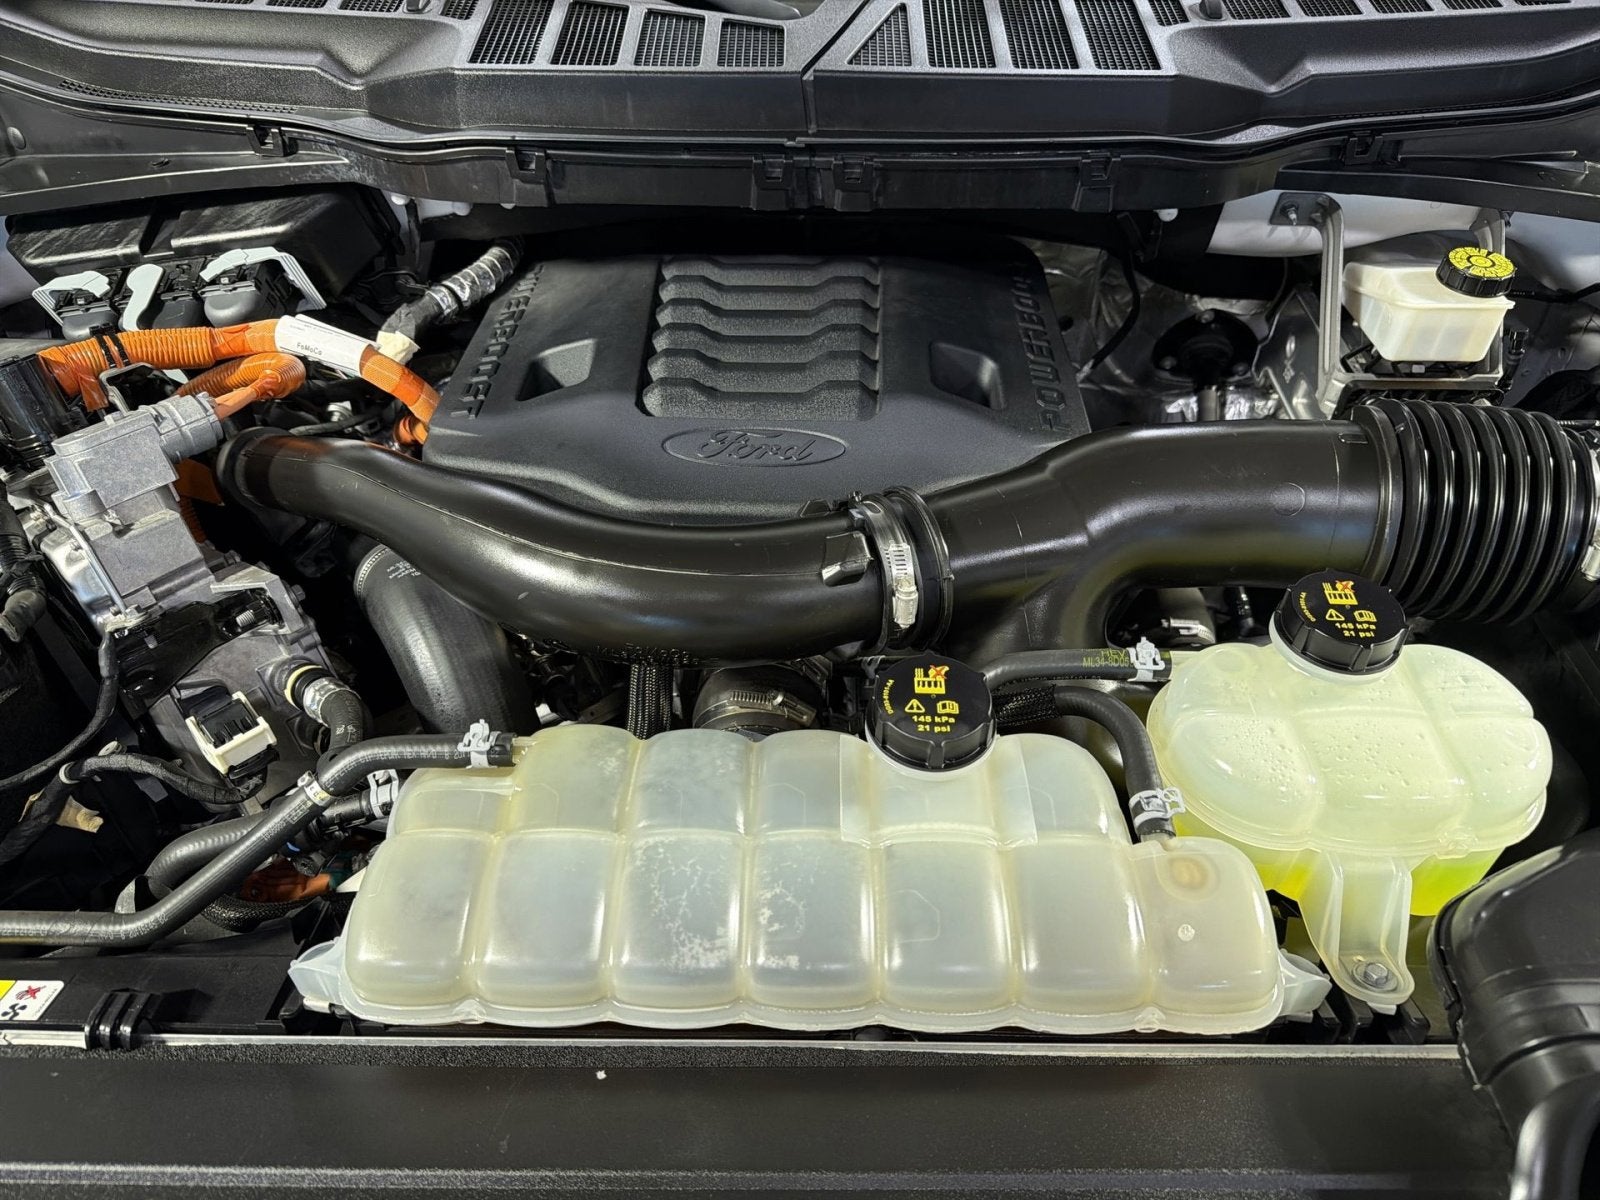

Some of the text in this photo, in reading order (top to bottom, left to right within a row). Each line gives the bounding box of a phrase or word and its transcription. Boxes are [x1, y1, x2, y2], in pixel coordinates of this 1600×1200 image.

[450, 263, 545, 420] OWERBOOST
[296, 342, 323, 356] FoMoCo
[1010, 273, 1071, 432] POWERBOO
[697, 429, 817, 461] Ford
[1335, 622, 1376, 630] 145 kPa
[1101, 648, 1125, 657] HEV
[912, 715, 956, 723] 145 kPa
[917, 724, 951, 734] 21 psi
